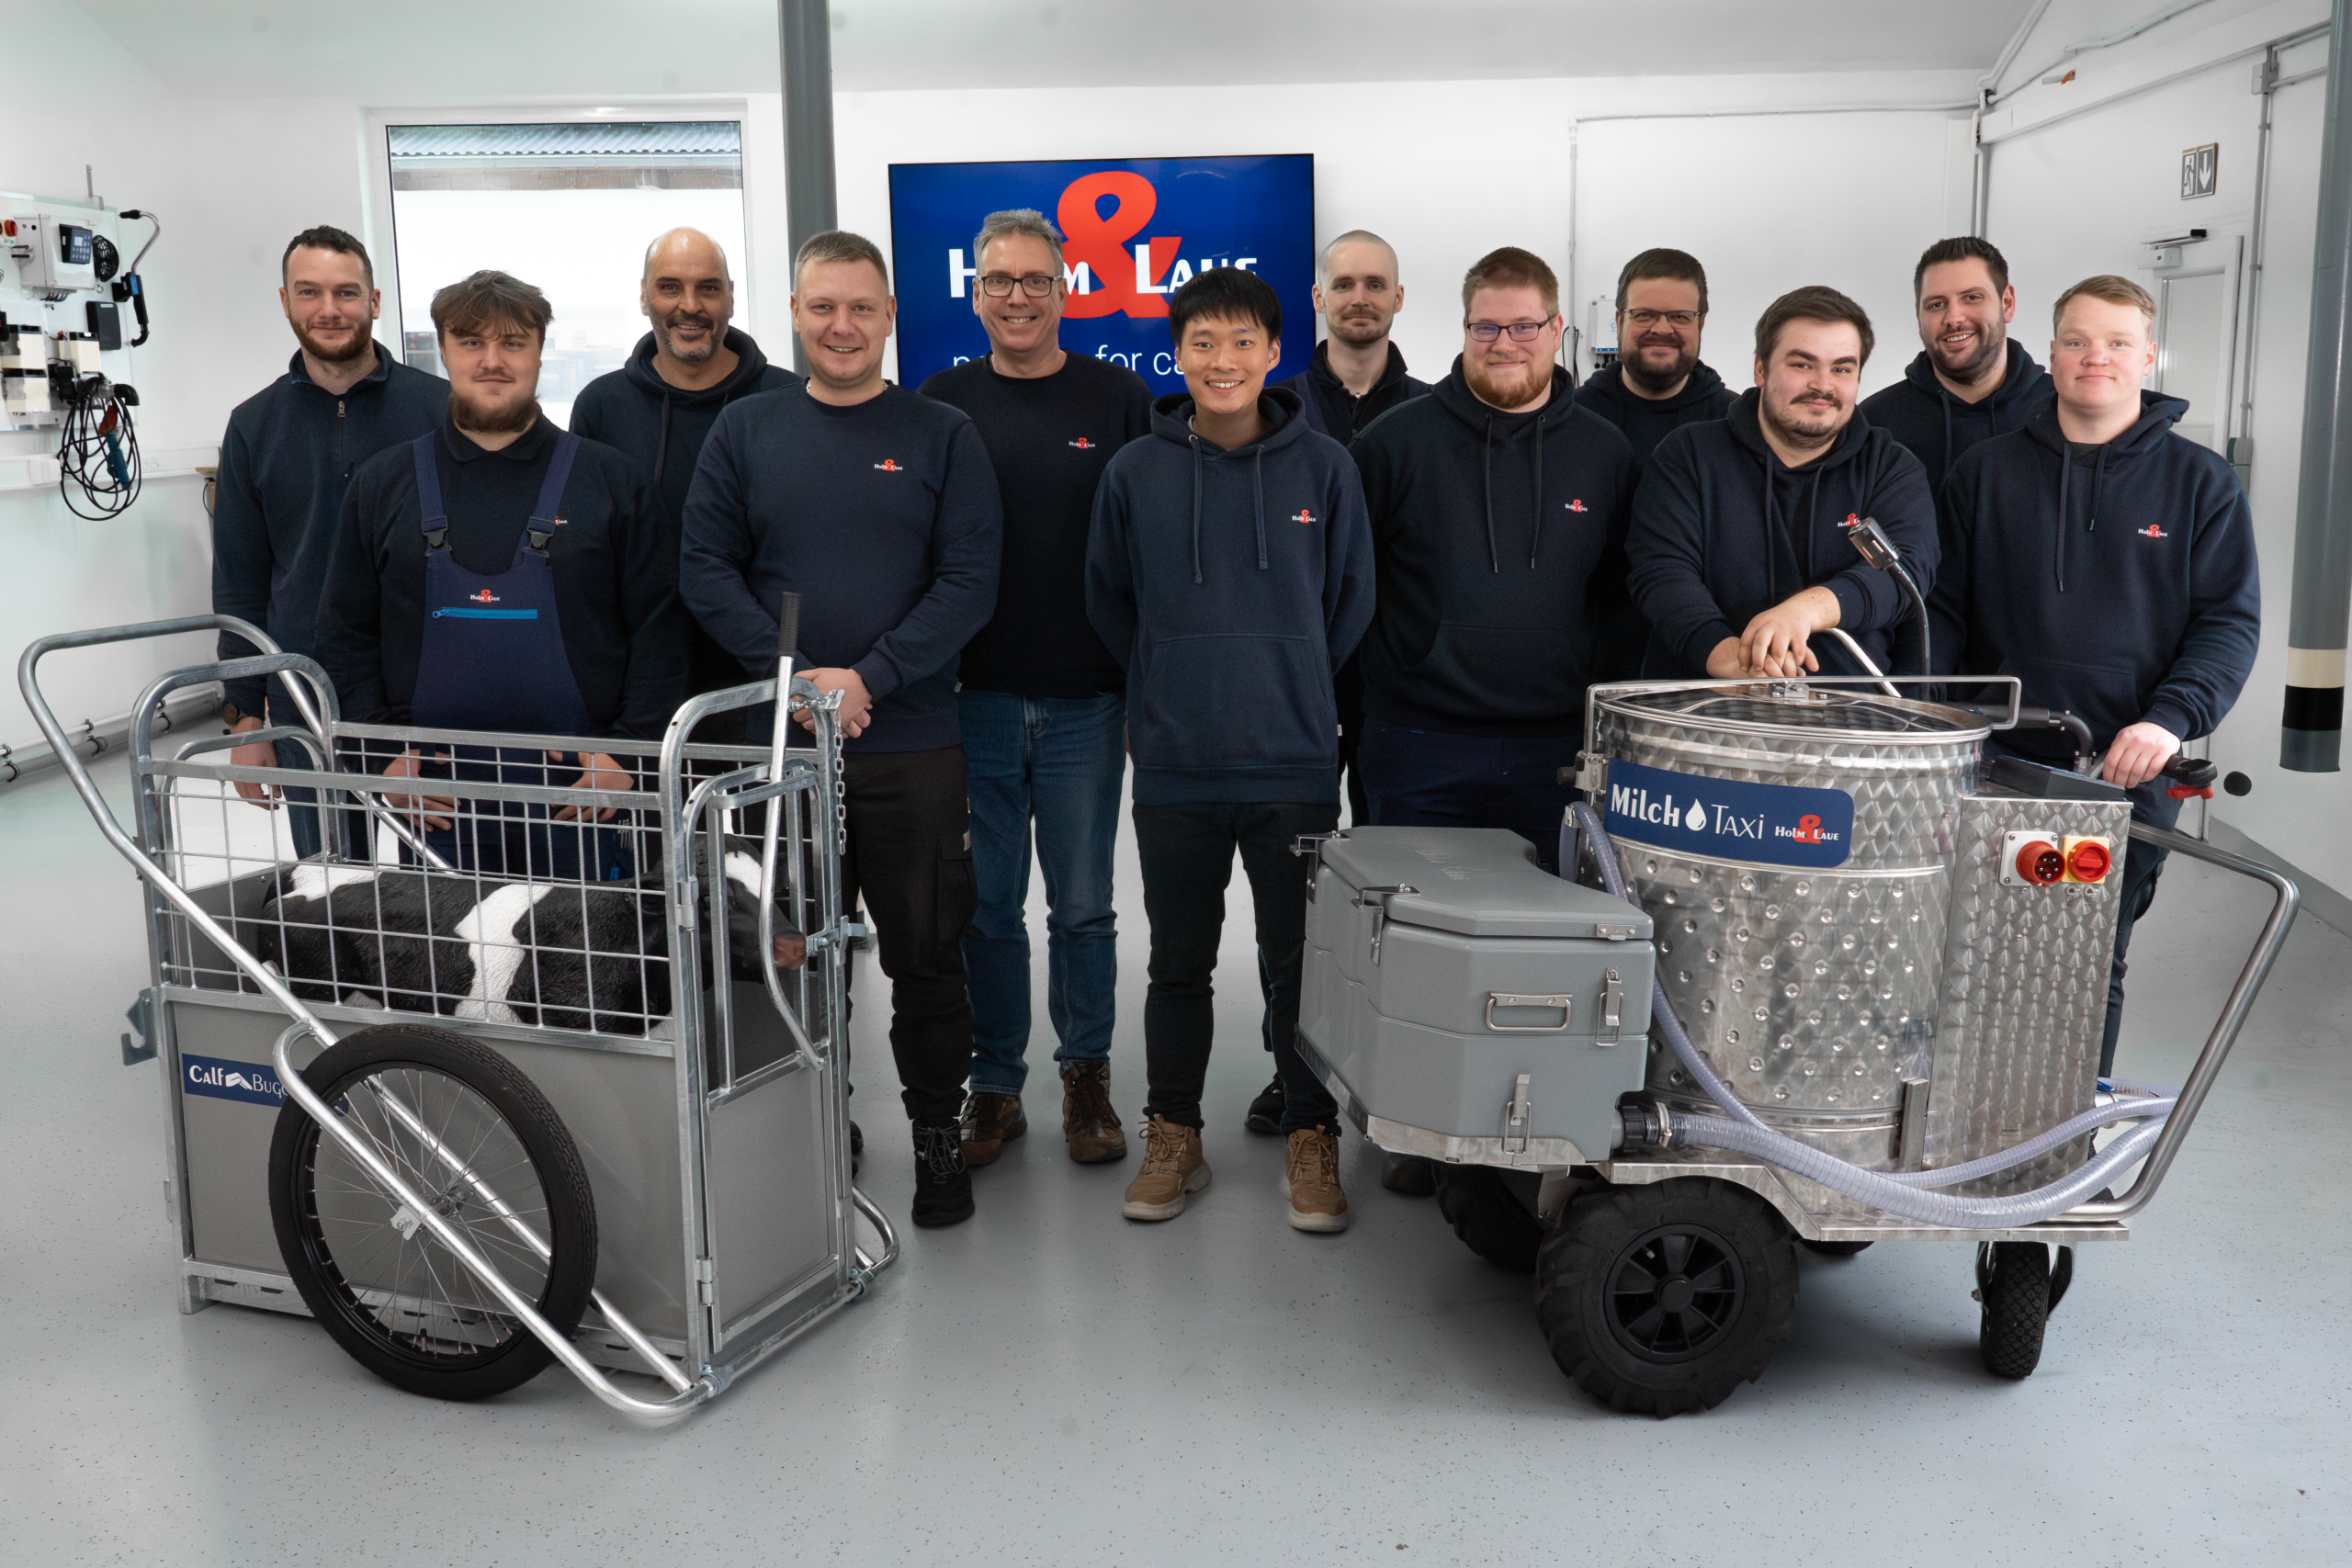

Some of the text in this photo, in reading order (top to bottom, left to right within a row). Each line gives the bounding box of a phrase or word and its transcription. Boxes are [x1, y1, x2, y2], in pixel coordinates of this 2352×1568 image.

[1057, 171, 1182, 319] &
[1611, 783, 1680, 828] Milch
[1792, 814, 1825, 844] &
